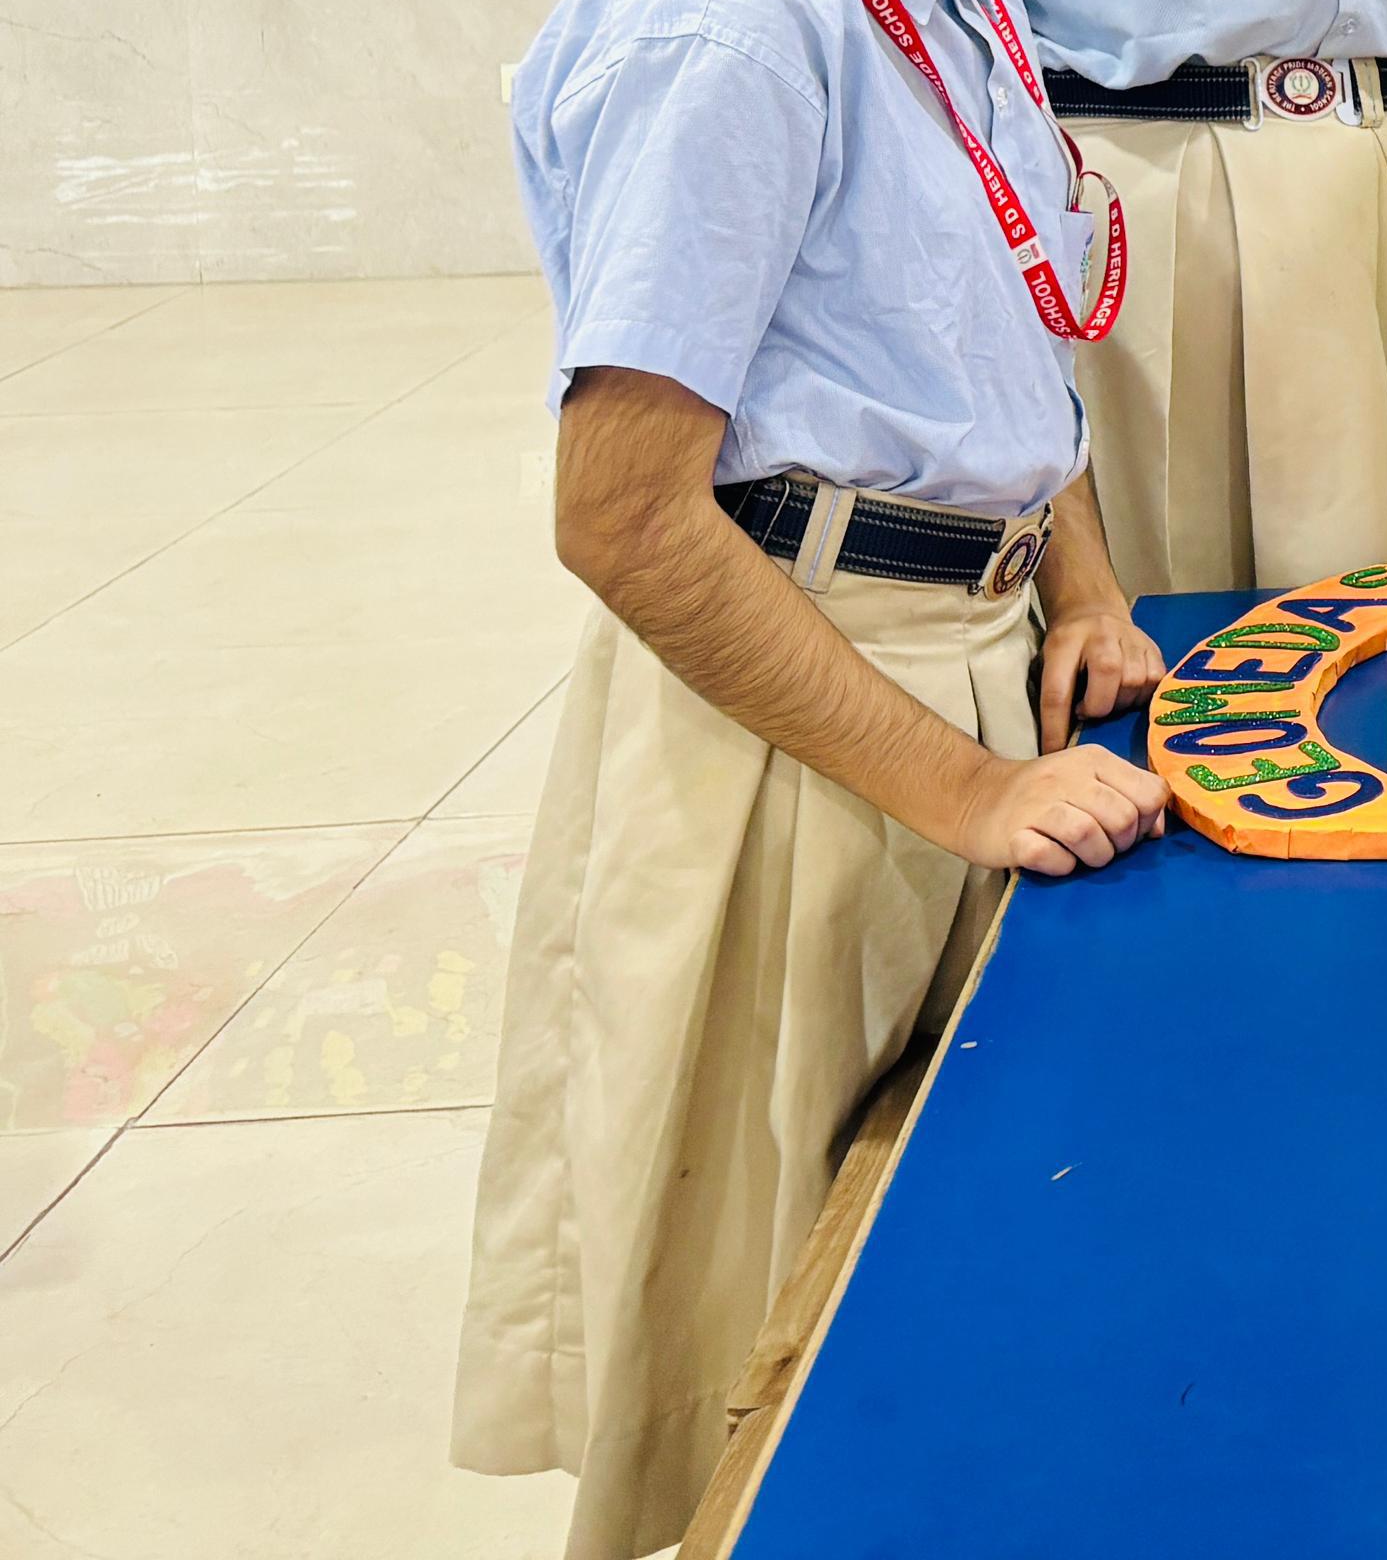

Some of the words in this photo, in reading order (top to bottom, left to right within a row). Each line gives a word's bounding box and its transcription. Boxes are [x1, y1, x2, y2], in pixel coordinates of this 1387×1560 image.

[910, 51, 947, 100] RIDE
[1283, 61, 1305, 70] PRIDE
[955, 114, 1008, 207] HERITAG
[1031, 270, 1071, 335] SCHOOL
[1091, 243, 1122, 327] HERITAGE
